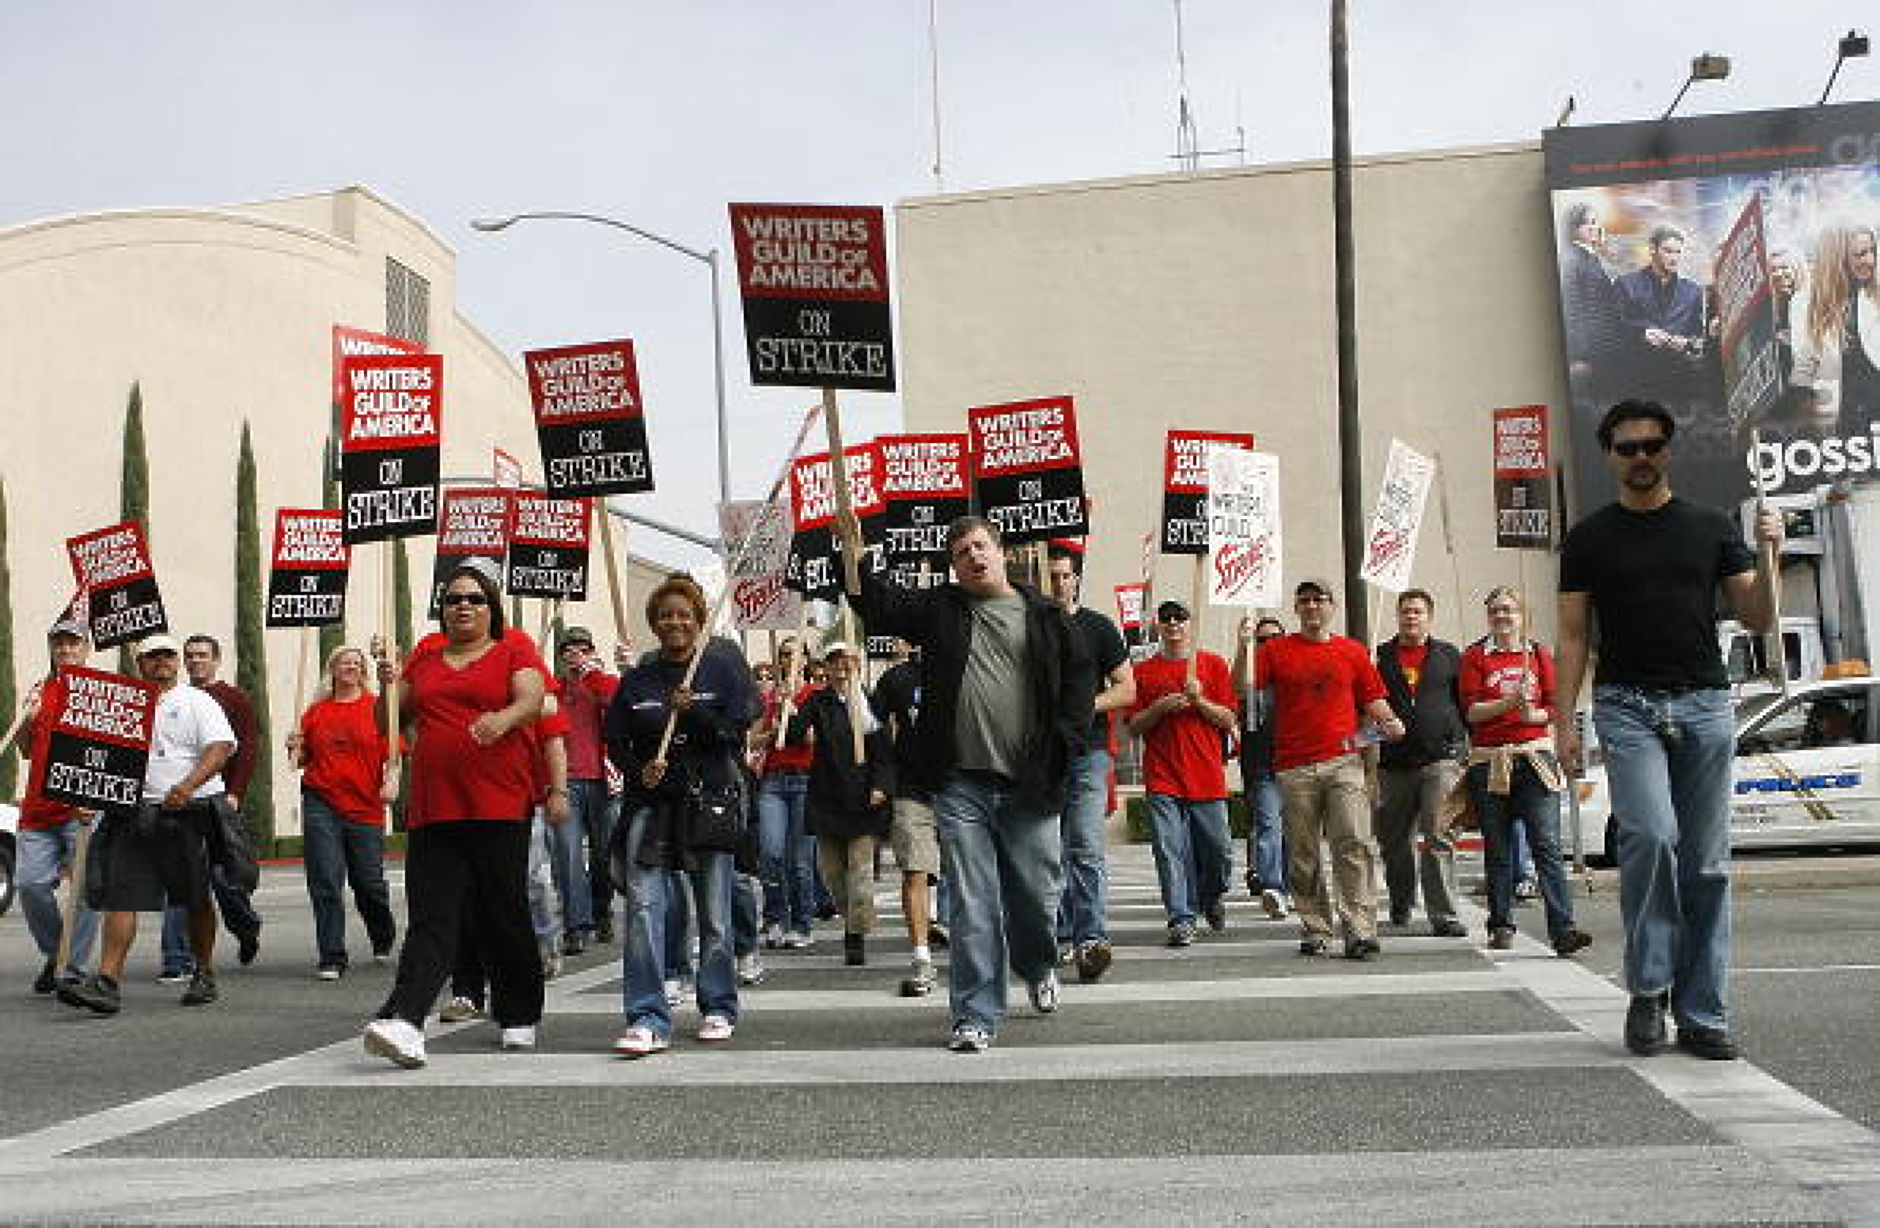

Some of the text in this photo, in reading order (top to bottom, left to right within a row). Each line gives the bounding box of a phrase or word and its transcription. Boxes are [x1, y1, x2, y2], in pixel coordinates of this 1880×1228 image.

[742, 215, 868, 242] WRITERS
[752, 239, 836, 263] GUILD
[750, 264, 880, 291] AMERICA
[798, 309, 830, 336] ON
[534, 351, 624, 377] WRITERS
[756, 336, 887, 377] STRIKE
[350, 366, 434, 390] WRITERS
[542, 378, 597, 398] GUILD
[353, 390, 409, 415] GUILD
[541, 389, 634, 417] AMERICA
[350, 413, 435, 440] AMERICA
[976, 407, 1064, 434] WRITERS
[579, 429, 603, 454] ON
[882, 442, 959, 459] WRITERS
[983, 428, 1041, 452] GUILD
[885, 459, 936, 475] GUILD
[982, 442, 1074, 469] AMERICA
[379, 458, 403, 485] ON
[549, 452, 646, 488] STRIKE
[882, 474, 963, 491] AMERICA
[1019, 480, 1042, 501] ON
[347, 486, 435, 529] STRIKE
[515, 499, 584, 517] WRITERS
[911, 506, 935, 523] ON
[986, 497, 1083, 533] STRIKE
[515, 525, 587, 541] AMERICA
[518, 513, 564, 532] GUILD
[1166, 519, 1209, 544] STR
[73, 529, 137, 560] WRITERS
[885, 525, 951, 551] STRIK
[279, 544, 346, 562] AMERICA
[512, 565, 585, 592] STRIKE
[271, 595, 342, 619] STRIKE
[94, 603, 163, 639] STRIKE
[66, 673, 148, 707] WRITERS
[66, 692, 122, 722] GUILD
[60, 710, 146, 742] AMERICA
[84, 747, 107, 768] ON
[48, 762, 139, 804] STRIKE
